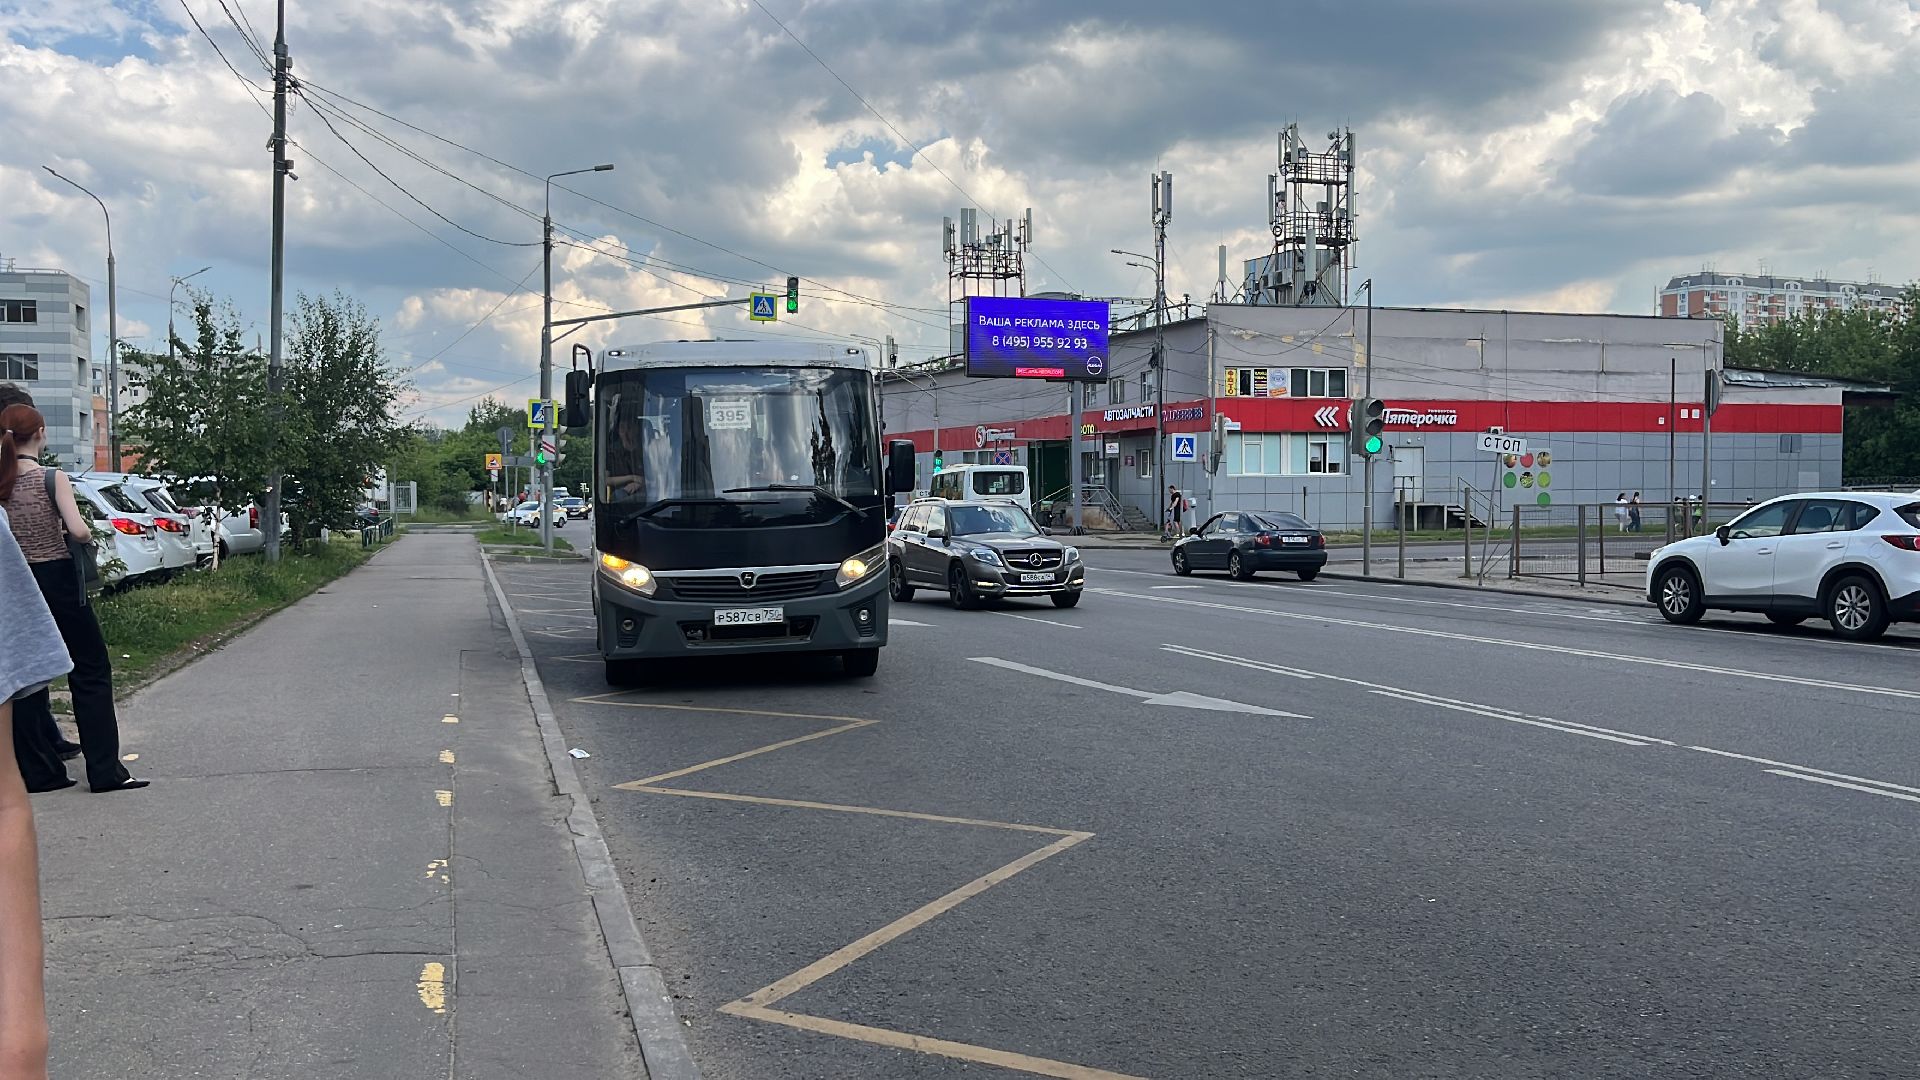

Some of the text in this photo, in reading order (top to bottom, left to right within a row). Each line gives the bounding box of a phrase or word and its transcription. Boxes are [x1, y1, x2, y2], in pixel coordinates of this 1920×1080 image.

[992, 335, 1088, 350] 8 (495) 955 92 93
[715, 410, 746, 421] 395
[1103, 405, 1154, 421] АВТОЗАПЧАСТИ
[1483, 436, 1521, 452] СТОП
